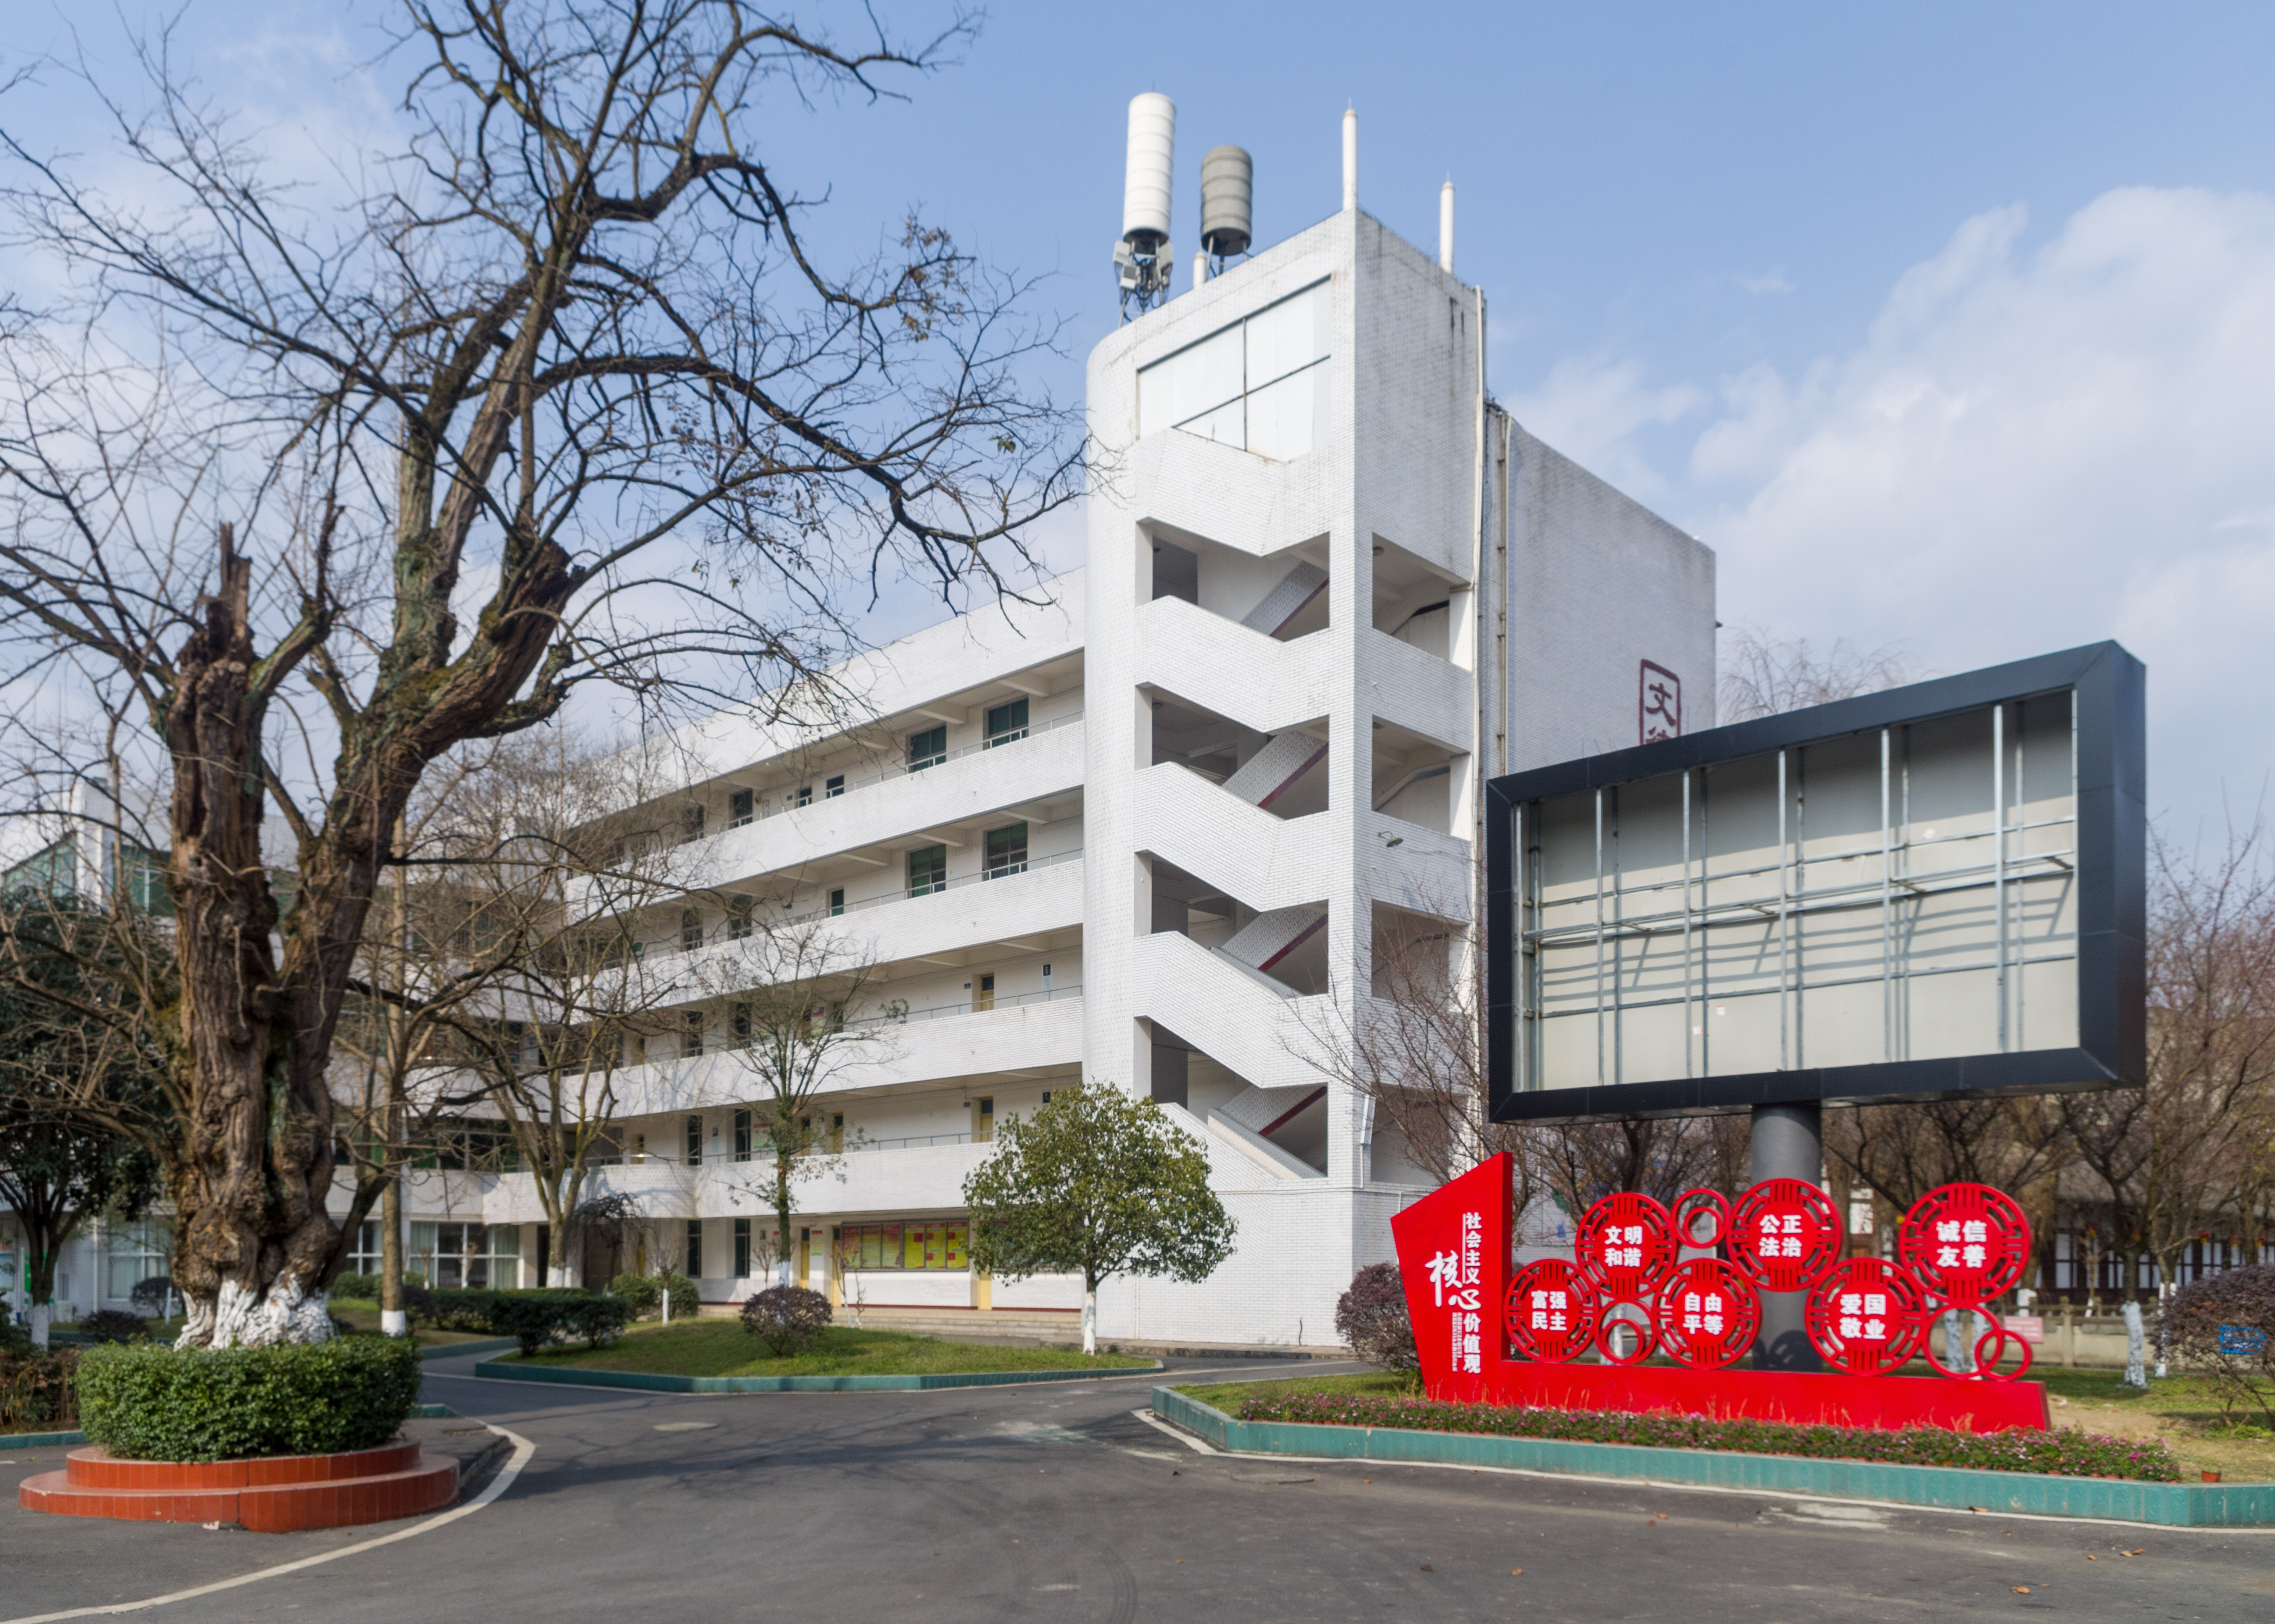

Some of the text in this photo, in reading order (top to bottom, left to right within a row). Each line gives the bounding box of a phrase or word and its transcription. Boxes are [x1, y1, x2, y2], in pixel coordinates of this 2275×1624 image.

[1759, 1214, 1803, 1234] 公正
[1936, 1219, 1987, 1242] 诚信
[1604, 1225, 1643, 1245] 文明
[1466, 1212, 1482, 1285] 社会主义
[1604, 1247, 1642, 1267] 和谐
[1758, 1236, 1802, 1257] 法治
[1936, 1244, 1986, 1268] 友善
[1425, 1250, 1481, 1310] 核心
[1531, 1290, 1567, 1310] 富强
[1684, 1292, 1722, 1313] 自由
[1840, 1293, 1886, 1316] 爱国
[1531, 1311, 1567, 1331] 民主
[1682, 1314, 1724, 1335] 平等
[1840, 1317, 1886, 1340] 敬业
[1463, 1313, 1481, 1374] 价值观
